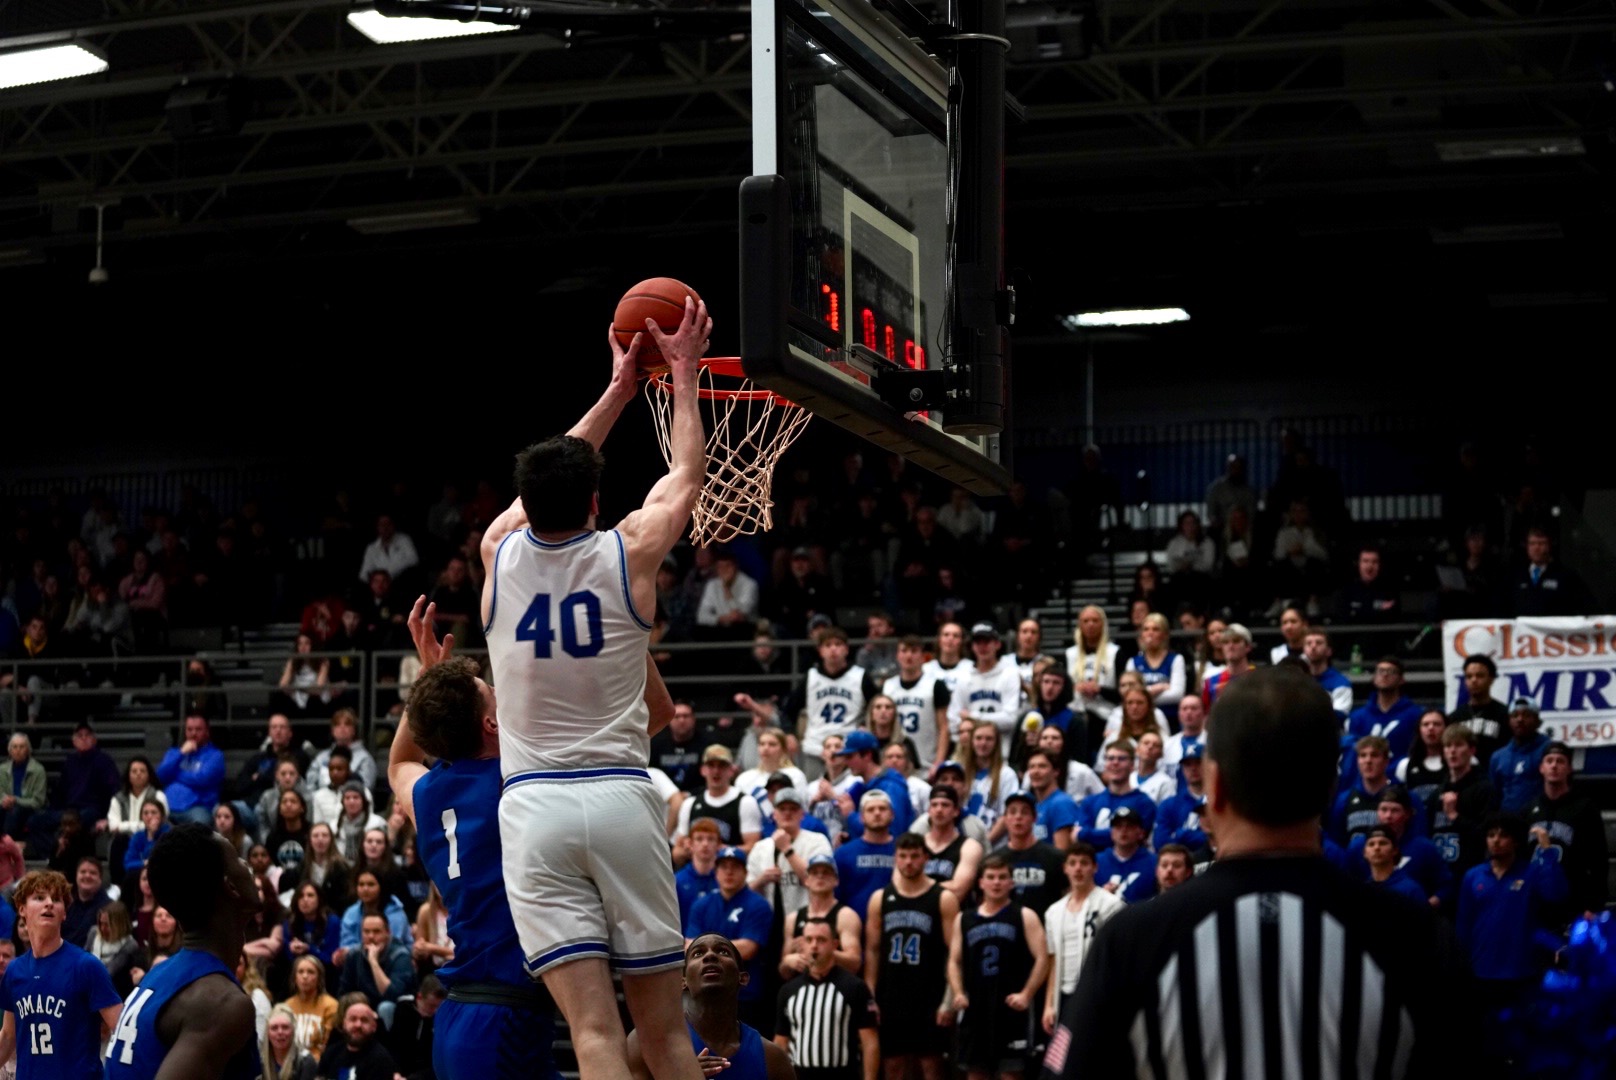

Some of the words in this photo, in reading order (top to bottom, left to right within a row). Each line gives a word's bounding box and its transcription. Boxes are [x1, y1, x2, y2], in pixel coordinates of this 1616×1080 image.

[515, 589, 605, 659] 40
[1453, 623, 1616, 662] Classi
[1455, 668, 1616, 713] MR
[820, 702, 848, 724] 42
[1561, 723, 1615, 742] 1450
[441, 807, 461, 880] 1
[1083, 908, 1099, 938] K
[888, 932, 921, 966] 14
[980, 944, 1000, 977] 2
[16, 993, 66, 1019] DMACC
[30, 1023, 53, 1055] 12
